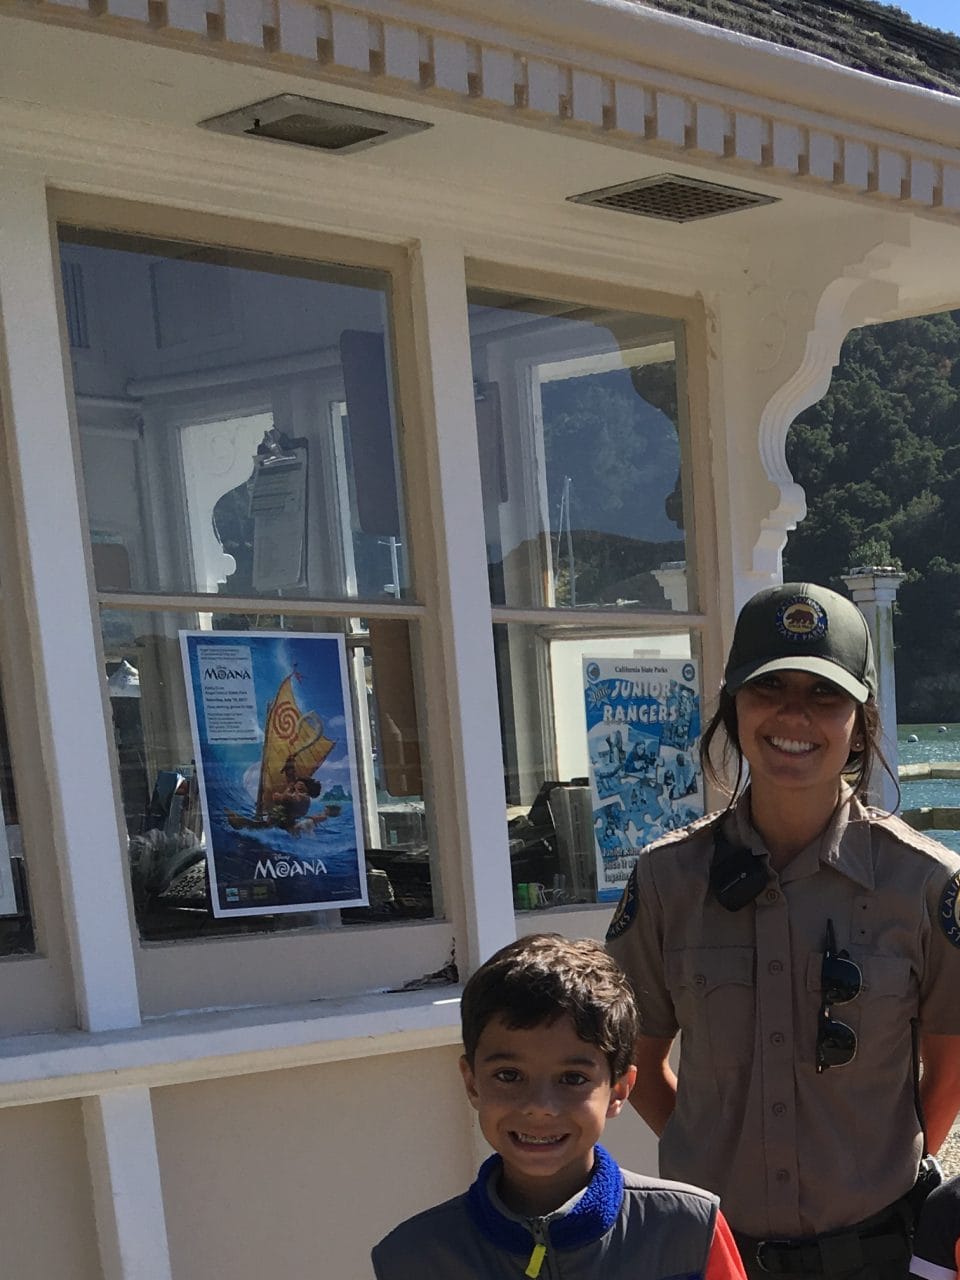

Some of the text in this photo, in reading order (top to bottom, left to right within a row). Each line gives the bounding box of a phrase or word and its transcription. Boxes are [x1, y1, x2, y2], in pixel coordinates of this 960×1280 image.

[204, 668, 251, 680] MOANA
[615, 665, 640, 674] California
[654, 665, 668, 673] Parks
[611, 680, 671, 698] JUNIOR
[603, 703, 677, 721] RANGERS
[253, 858, 327, 880] MOANA
